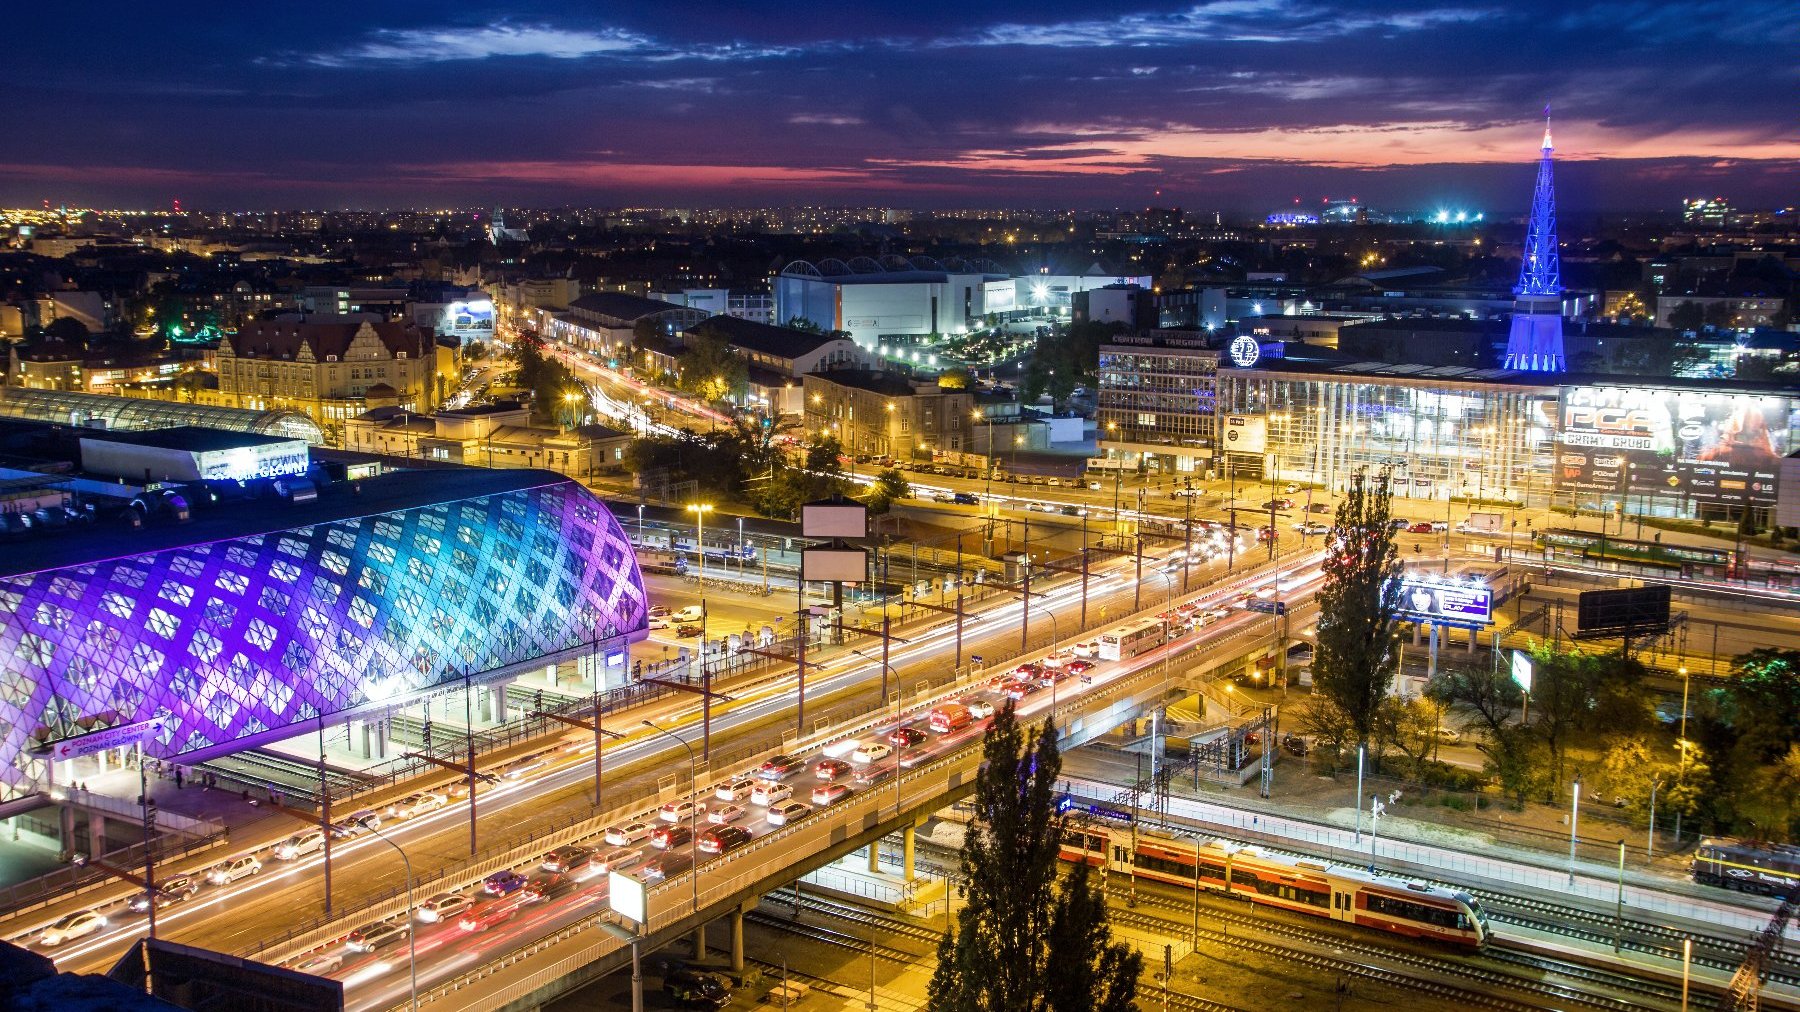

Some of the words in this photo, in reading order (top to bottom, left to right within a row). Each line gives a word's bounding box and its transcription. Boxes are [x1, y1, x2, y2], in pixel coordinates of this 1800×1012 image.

[1165, 338, 1208, 347] TARGOWE
[1567, 434, 1605, 446] GRAMY
[1612, 437, 1651, 448] GRUBO
[72, 733, 104, 748] POZNAŃ
[104, 730, 120, 740] CITY
[122, 722, 150, 734] CENTER
[78, 740, 110, 754] POZNAŃ
